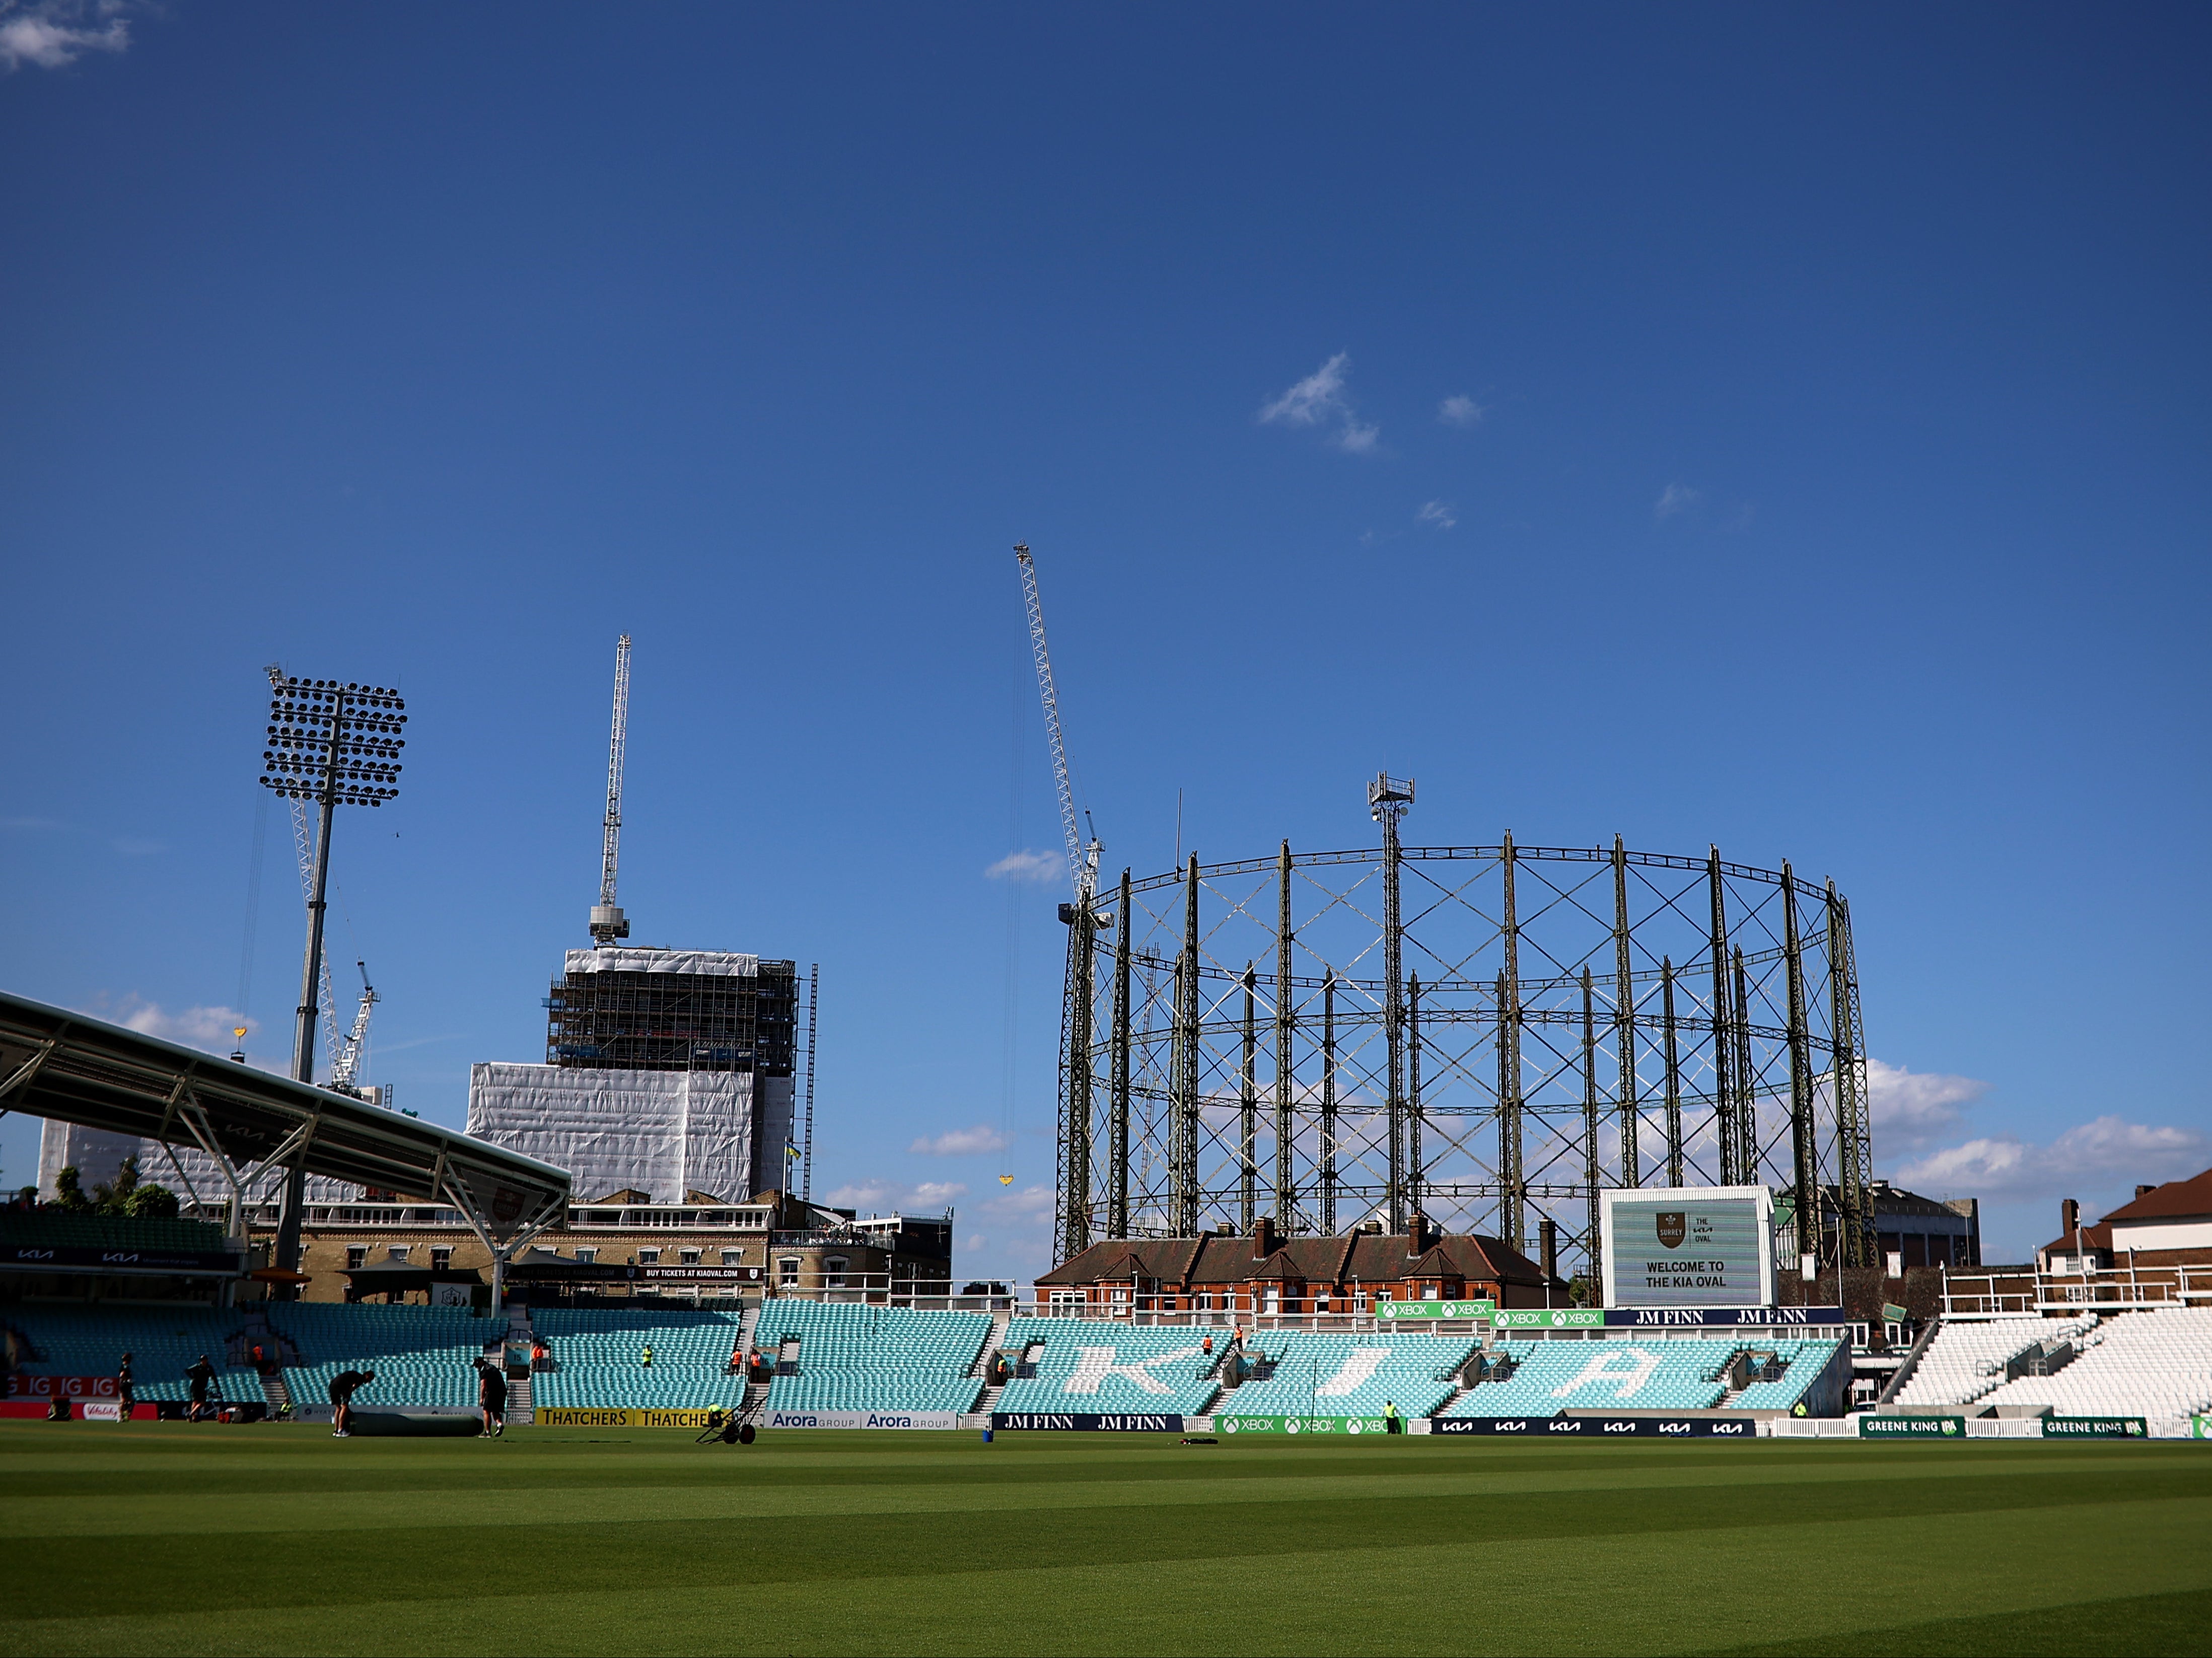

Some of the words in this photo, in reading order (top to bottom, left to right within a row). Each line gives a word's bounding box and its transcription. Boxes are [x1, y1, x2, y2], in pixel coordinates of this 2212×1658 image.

[1647, 1262, 1705, 1272] WELCOME
[1708, 1261, 1724, 1272] TO
[1646, 1277, 1669, 1287] THE
[1673, 1277, 1693, 1287] KIA
[1696, 1276, 1726, 1287] OVAL
[1399, 1305, 1427, 1315] XBOX
[1458, 1304, 1486, 1314] XBOX
[1512, 1314, 1541, 1324] XBOX
[1568, 1314, 1598, 1324] XBOX
[1636, 1311, 1659, 1324] JM
[1663, 1311, 1703, 1324] FINN
[1737, 1310, 1761, 1324] JM
[1765, 1310, 1807, 1324] FINN
[29, 1377, 50, 1395] IG
[60, 1378, 82, 1396] IG
[92, 1378, 114, 1396] IG
[543, 1409, 626, 1425] THATCHERS
[642, 1411, 711, 1426] THATCHE
[772, 1413, 817, 1427] Arora
[867, 1414, 910, 1427] Arora
[1005, 1415, 1028, 1428] JM
[1033, 1415, 1074, 1429] FINN
[1098, 1416, 1121, 1429] JM
[1126, 1416, 1167, 1430] FINN
[1241, 1419, 1274, 1431] XBOX
[1303, 1420, 1335, 1431] XBOX
[1365, 1420, 1388, 1431] XBO
[1442, 1422, 1472, 1431] KIA
[1495, 1421, 1526, 1431] KIA
[1549, 1421, 1581, 1431] KIA
[1604, 1422, 1635, 1432] KIA
[1659, 1423, 1690, 1432] KIA
[1712, 1423, 1742, 1433] KIA
[1867, 1421, 1907, 1431] GREENE
[1910, 1421, 1938, 1431] KING
[1941, 1419, 1957, 1433] IPA
[2047, 1421, 2090, 1432] GREENE
[2125, 1420, 2142, 1434] IPA
